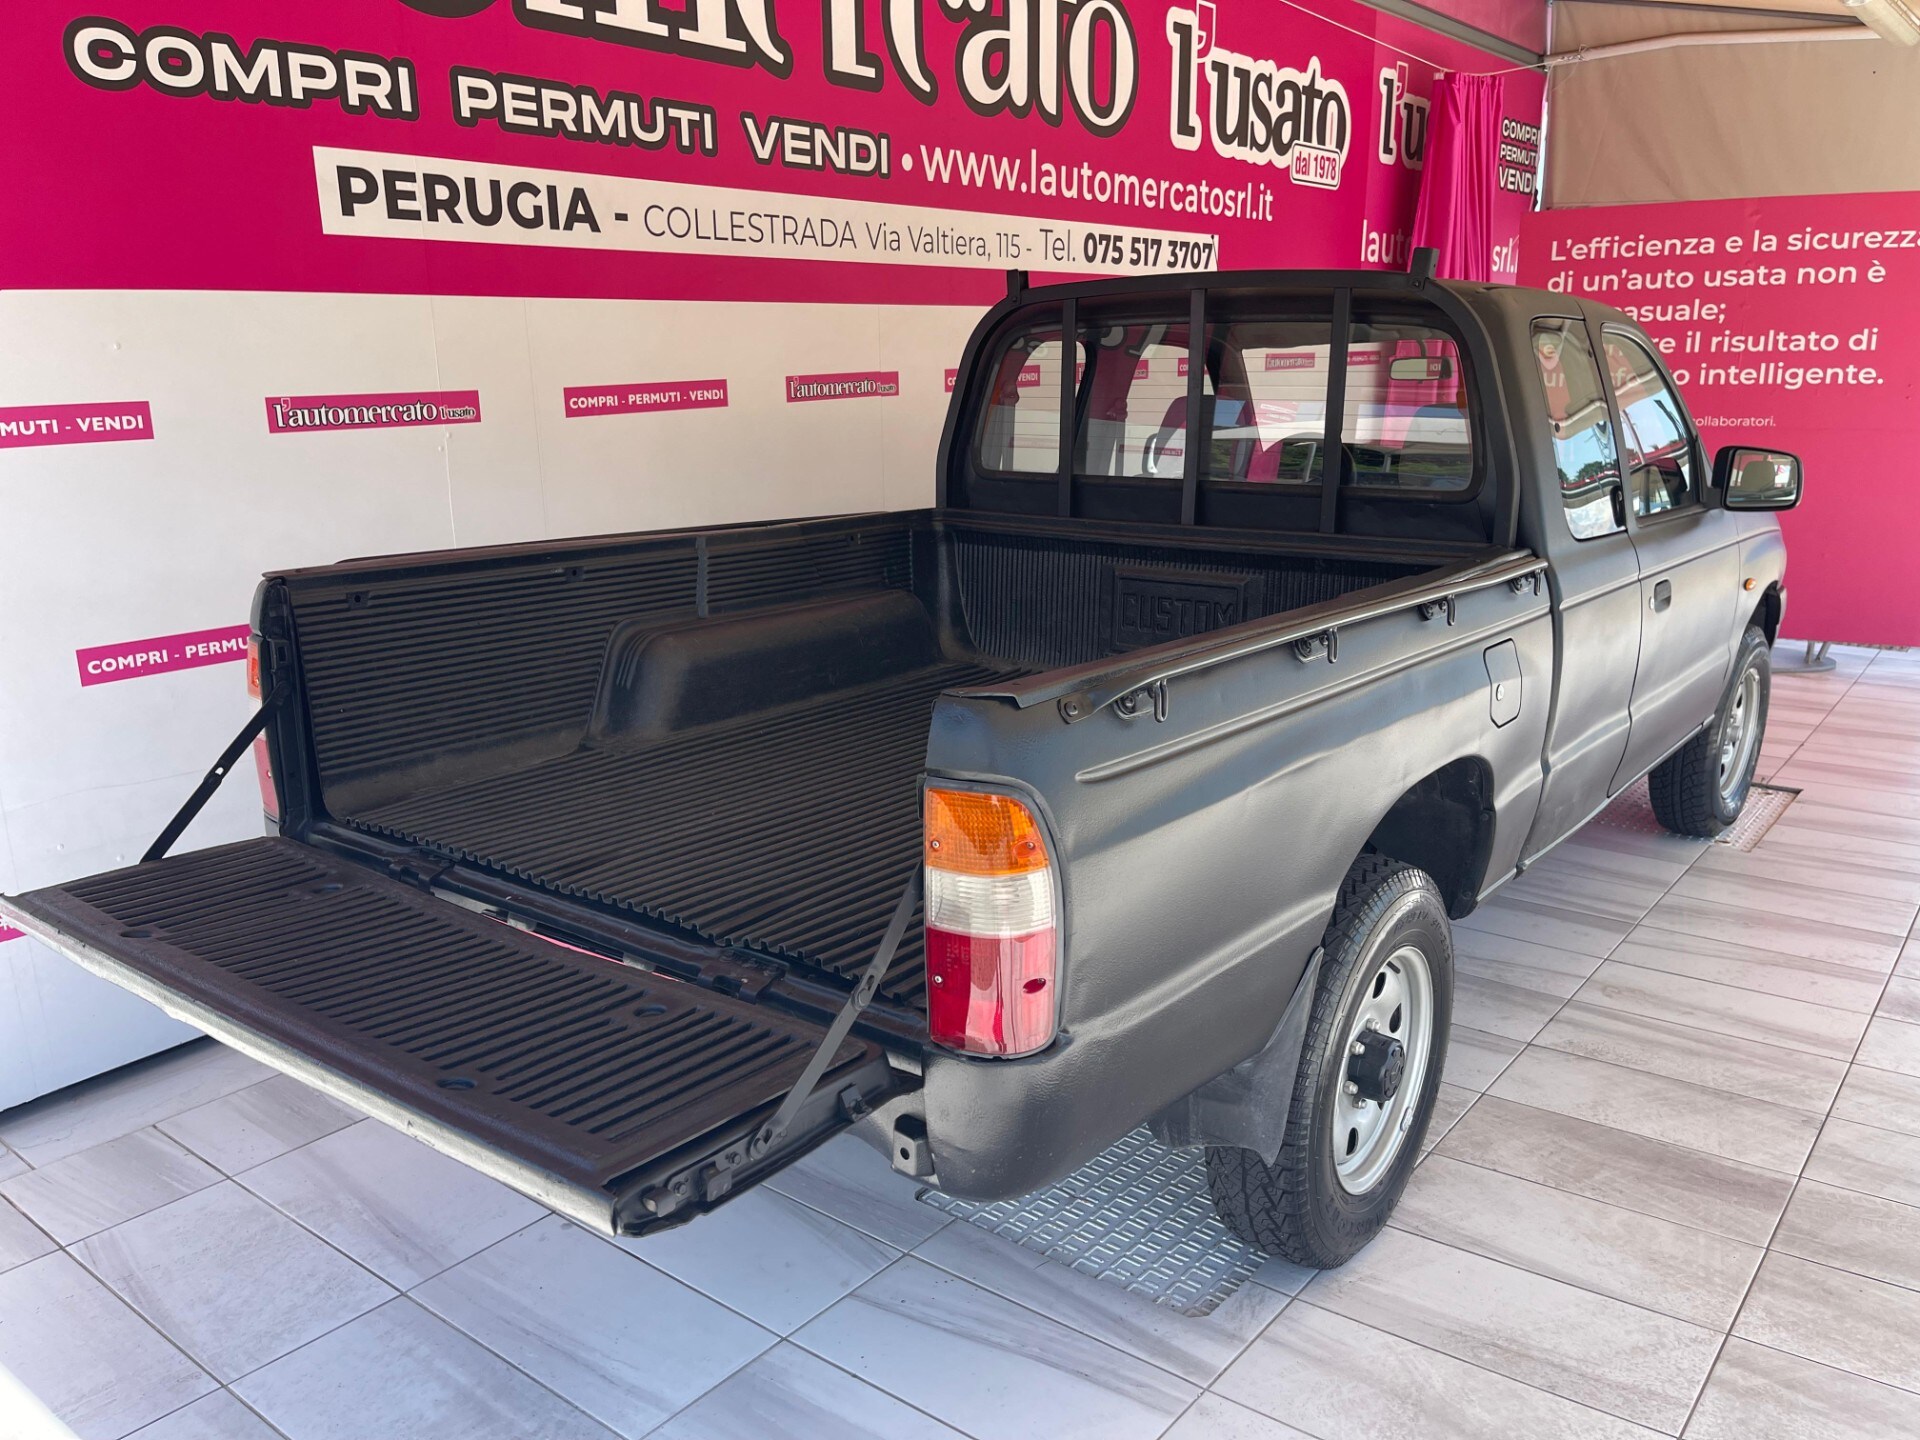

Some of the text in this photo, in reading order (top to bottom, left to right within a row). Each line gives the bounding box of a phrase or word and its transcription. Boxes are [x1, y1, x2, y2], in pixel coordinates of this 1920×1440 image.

[1168, 1, 1350, 164] l'usato
[73, 27, 1273, 222] COMPRI PERMUTI VENDI www.lautomercatosrl.it
[1295, 151, 1337, 182] dal 1978
[336, 165, 601, 233] PERUGIA
[643, 204, 857, 250] COLLESTRADA
[866, 222, 901, 252] Via
[908, 226, 991, 261] Valtiera,
[996, 233, 1021, 260] 115
[1039, 229, 1076, 263] Tel.
[1083, 233, 1124, 266] 075
[1129, 238, 1161, 269] 517
[1165, 241, 1213, 271] 3707
[1551, 227, 1920, 261] L'efficienza e la sicurezz
[1547, 260, 1887, 293] di un'auto usata non è
[1614, 298, 1726, 324] asuale;
[1686, 331, 1701, 353] il
[1710, 330, 1839, 352] risultato
[1849, 328, 1878, 351] di
[789, 376, 876, 398] l'automercato
[1700, 362, 1884, 390] intelligente.
[273, 398, 437, 428] l'automercato
[569, 395, 618, 410] COMPRI
[628, 391, 681, 405] PERMUTI
[690, 389, 724, 402] VENDI
[0, 419, 59, 437] MUTI
[76, 415, 144, 432] VENDI
[1122, 592, 1238, 636] CUSTOM
[87, 649, 169, 674] COMPRI
[185, 636, 250, 659] PERMU
